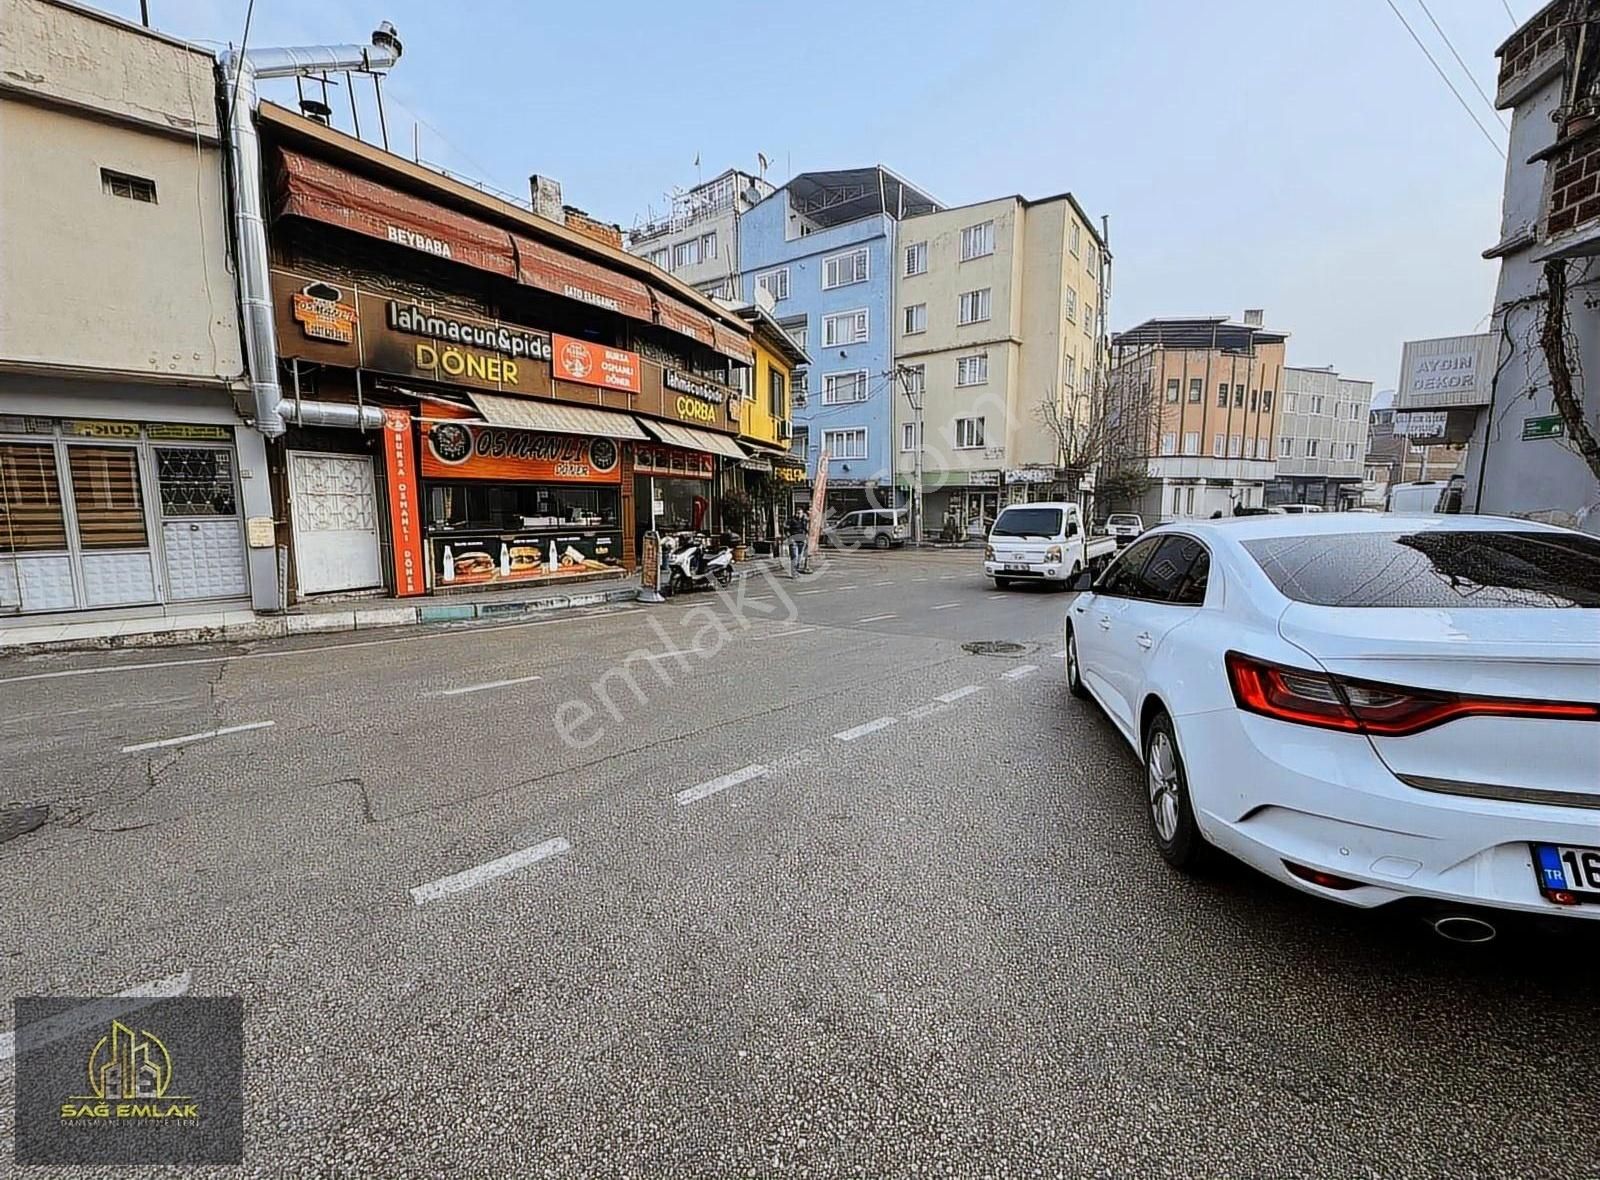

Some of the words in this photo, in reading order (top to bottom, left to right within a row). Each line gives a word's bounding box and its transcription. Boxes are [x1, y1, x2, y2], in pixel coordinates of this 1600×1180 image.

[388, 226, 452, 258] BEYBABA
[391, 301, 551, 359] lahmacun&pide
[416, 343, 518, 384] DÖNER
[1416, 356, 1472, 373] AYDIN
[1414, 374, 1474, 390] DEKOR
[677, 396, 716, 422] ÇORBA
[395, 433, 405, 476] BURSA
[475, 430, 589, 462] OSMANLI
[398, 483, 409, 542] OSMANLI
[1544, 868, 1563, 880] TR
